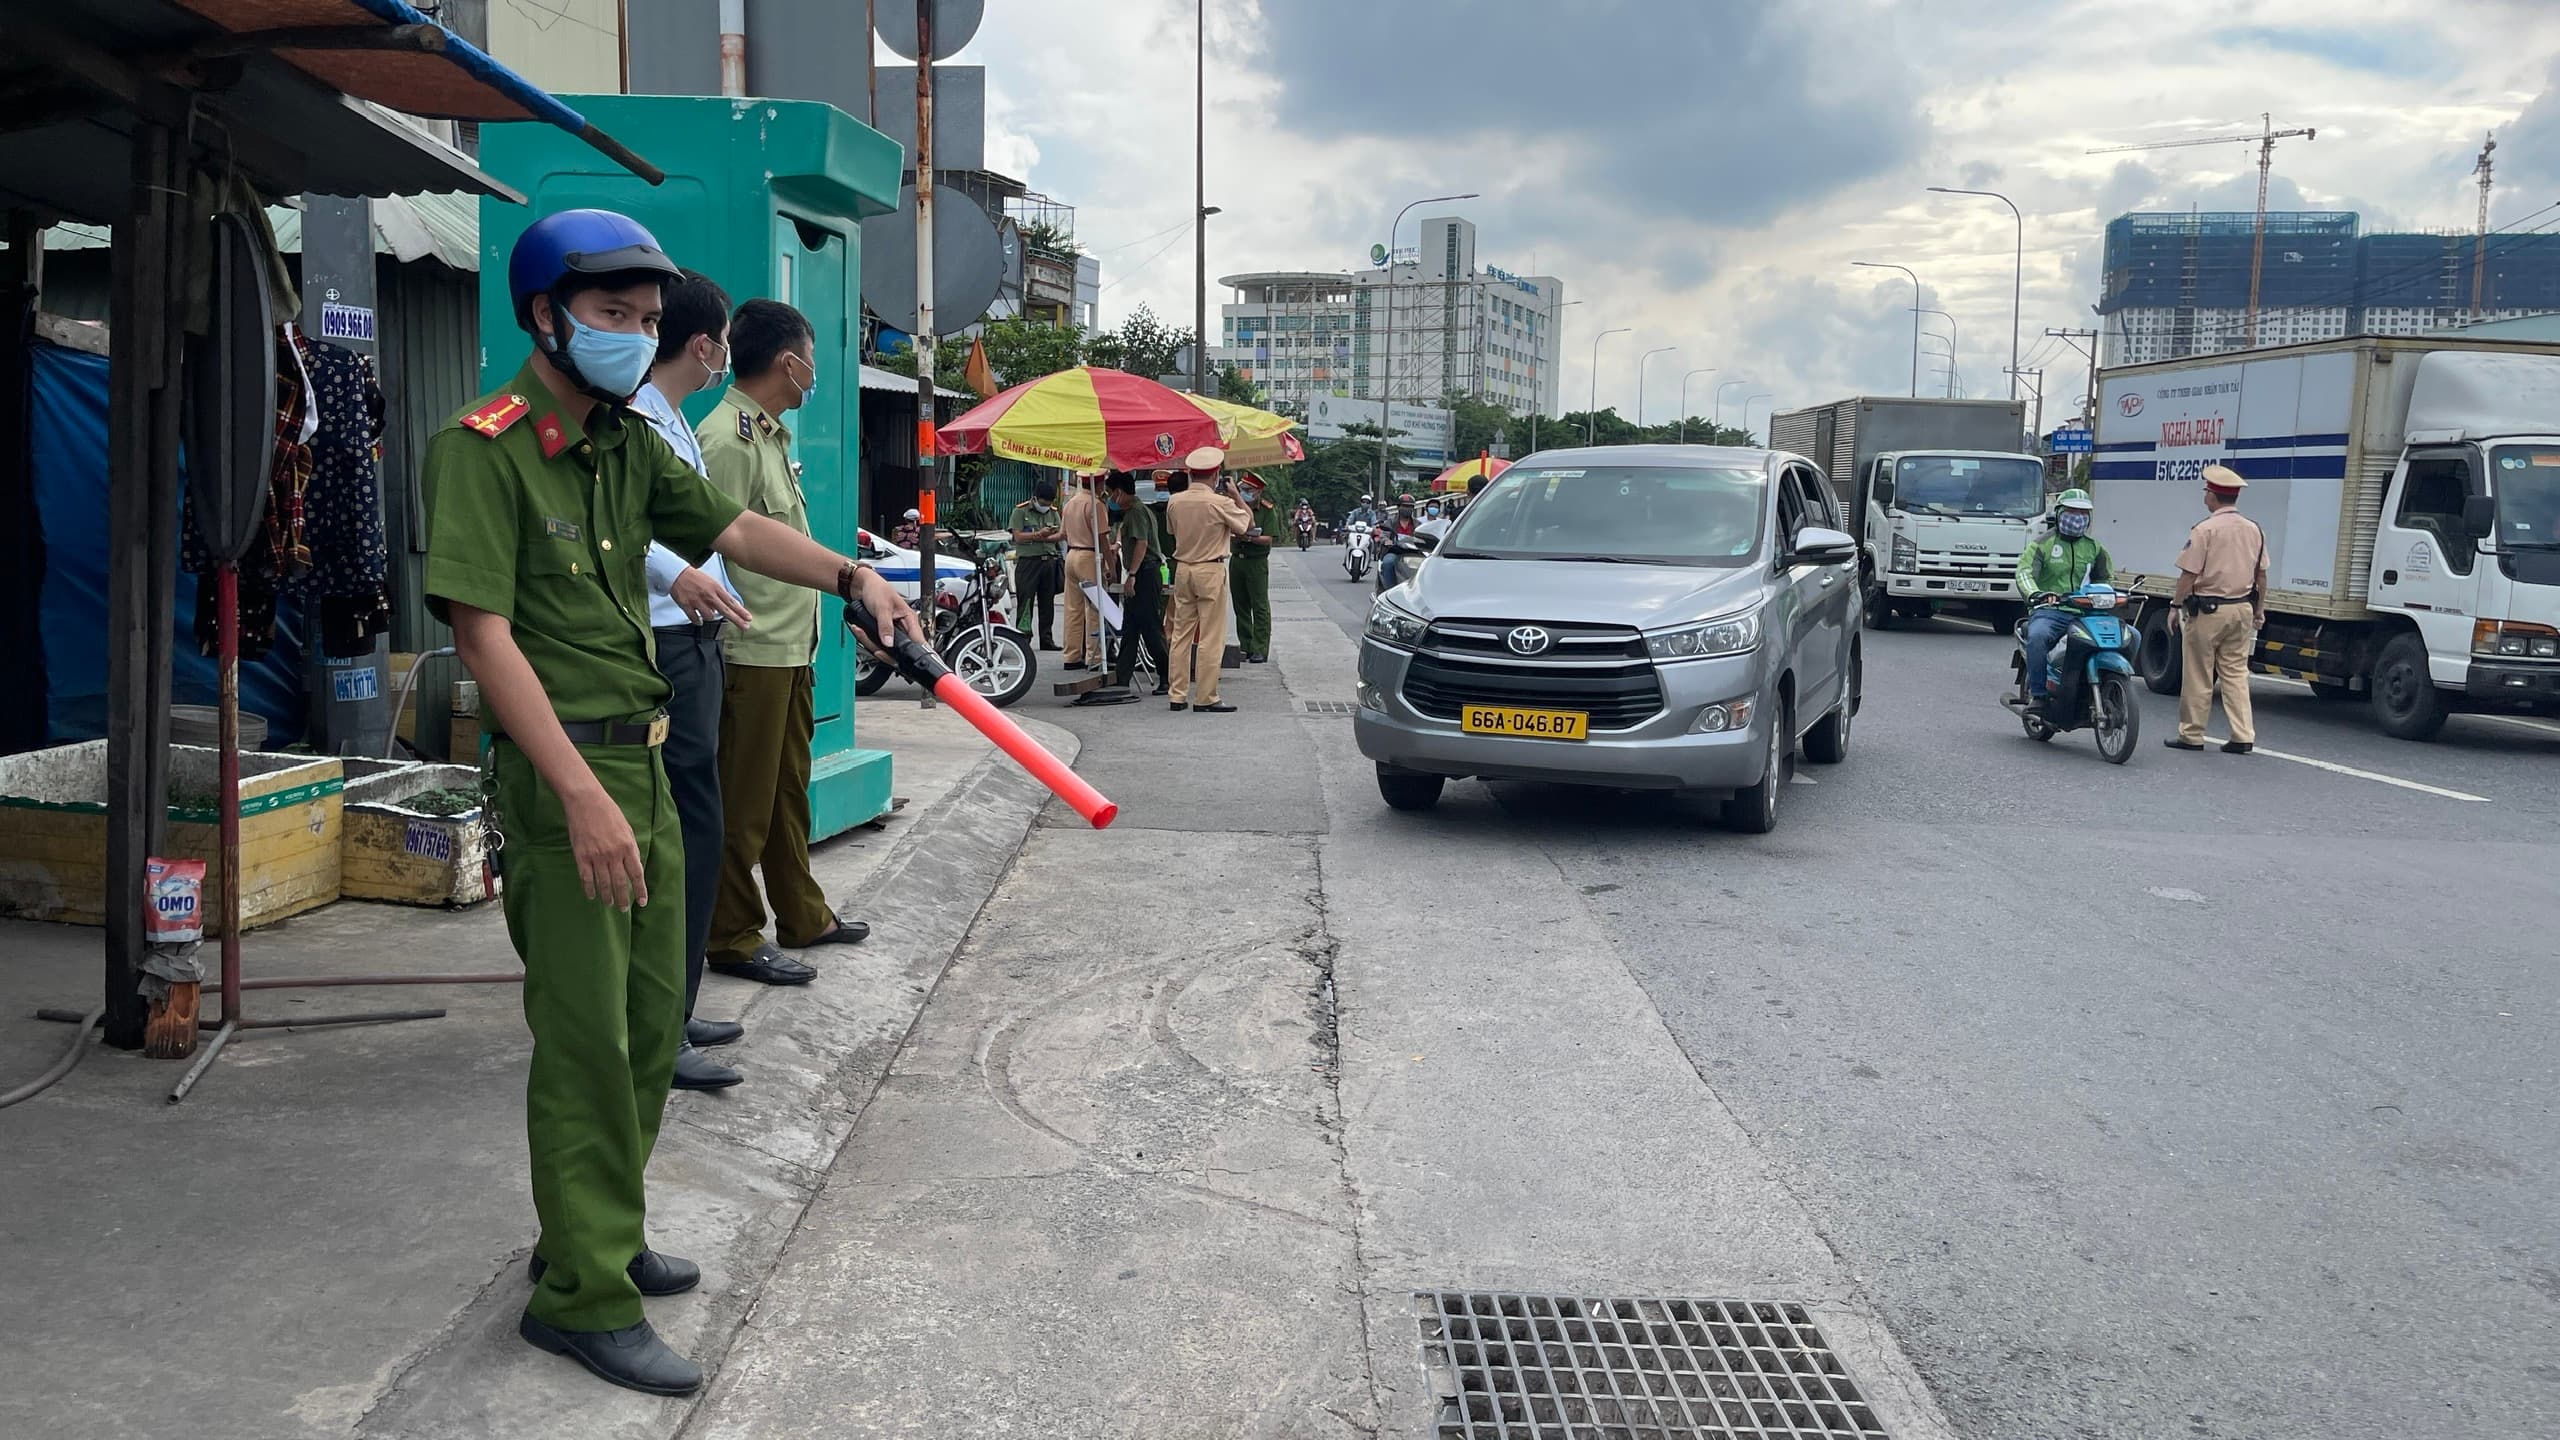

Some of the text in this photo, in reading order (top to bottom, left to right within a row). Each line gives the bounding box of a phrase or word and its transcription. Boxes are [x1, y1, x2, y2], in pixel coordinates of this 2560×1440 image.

[1044, 449, 1064, 461] GIAO
[1066, 453, 1094, 467] THÔNG
[2291, 578, 2329, 588] FORWARD
[1472, 711, 1576, 734] 66A-046.87
[159, 896, 195, 911] OMO
